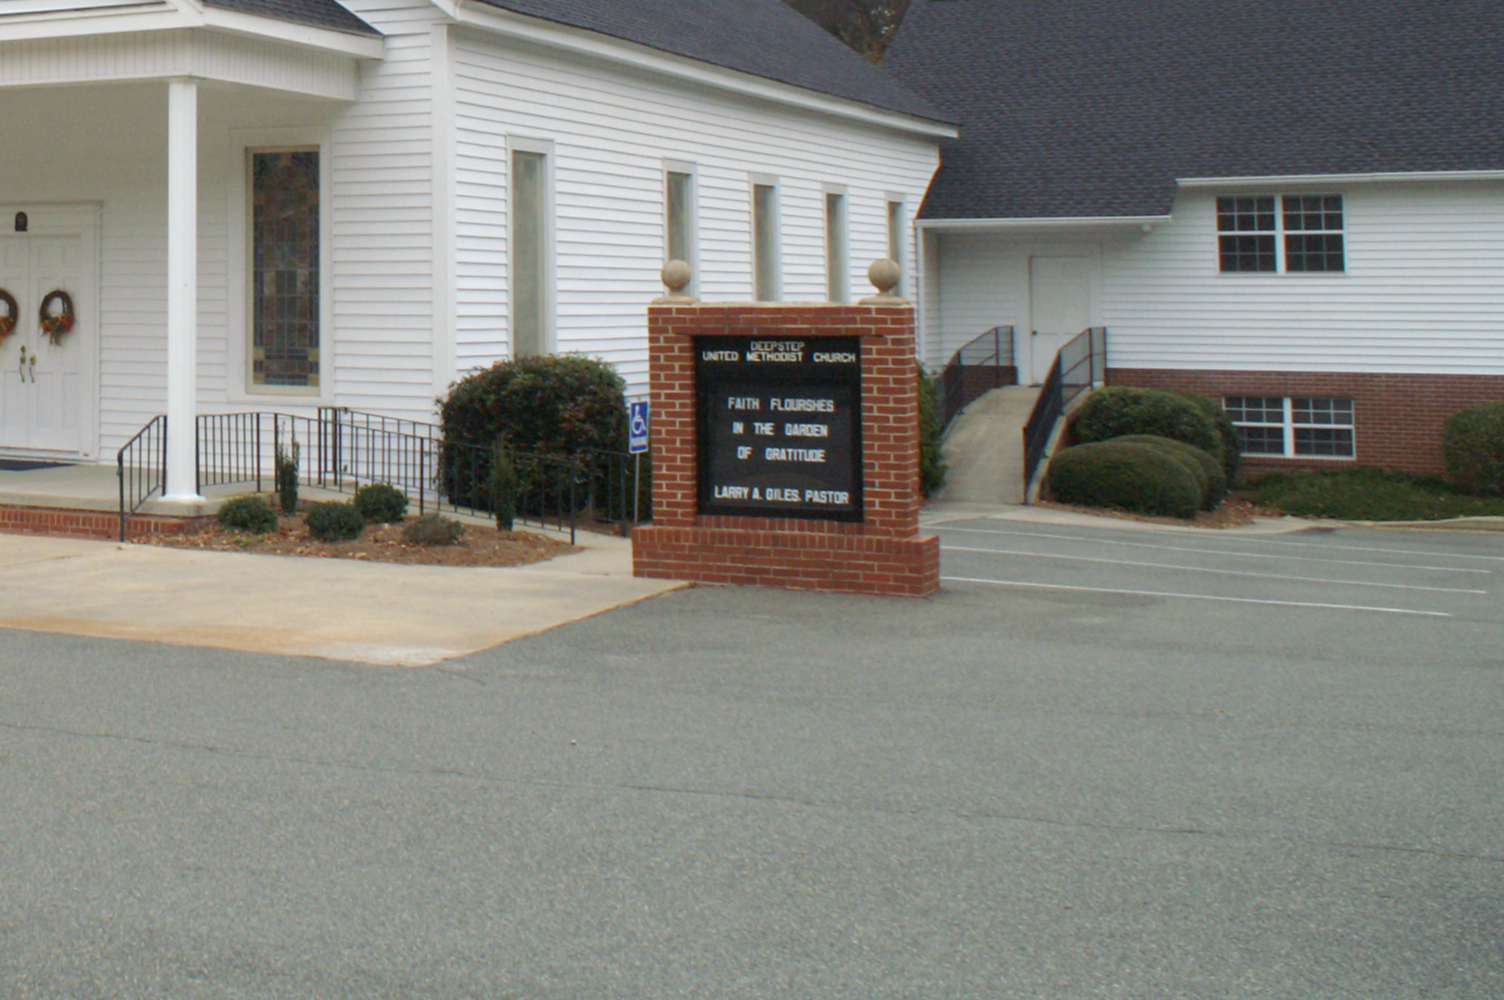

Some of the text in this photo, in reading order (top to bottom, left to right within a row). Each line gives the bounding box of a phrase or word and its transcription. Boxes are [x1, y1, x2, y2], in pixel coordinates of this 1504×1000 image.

[751, 341, 804, 351] DEEPSTEP
[702, 351, 856, 362] UNITED METHODIST CHURCH
[728, 397, 760, 410] FAITH
[733, 422, 828, 437] IN THE GARDEN
[737, 446, 826, 462] OF GRATITUDE
[714, 486, 749, 499] LARRY
[805, 490, 849, 504] PASTOR
